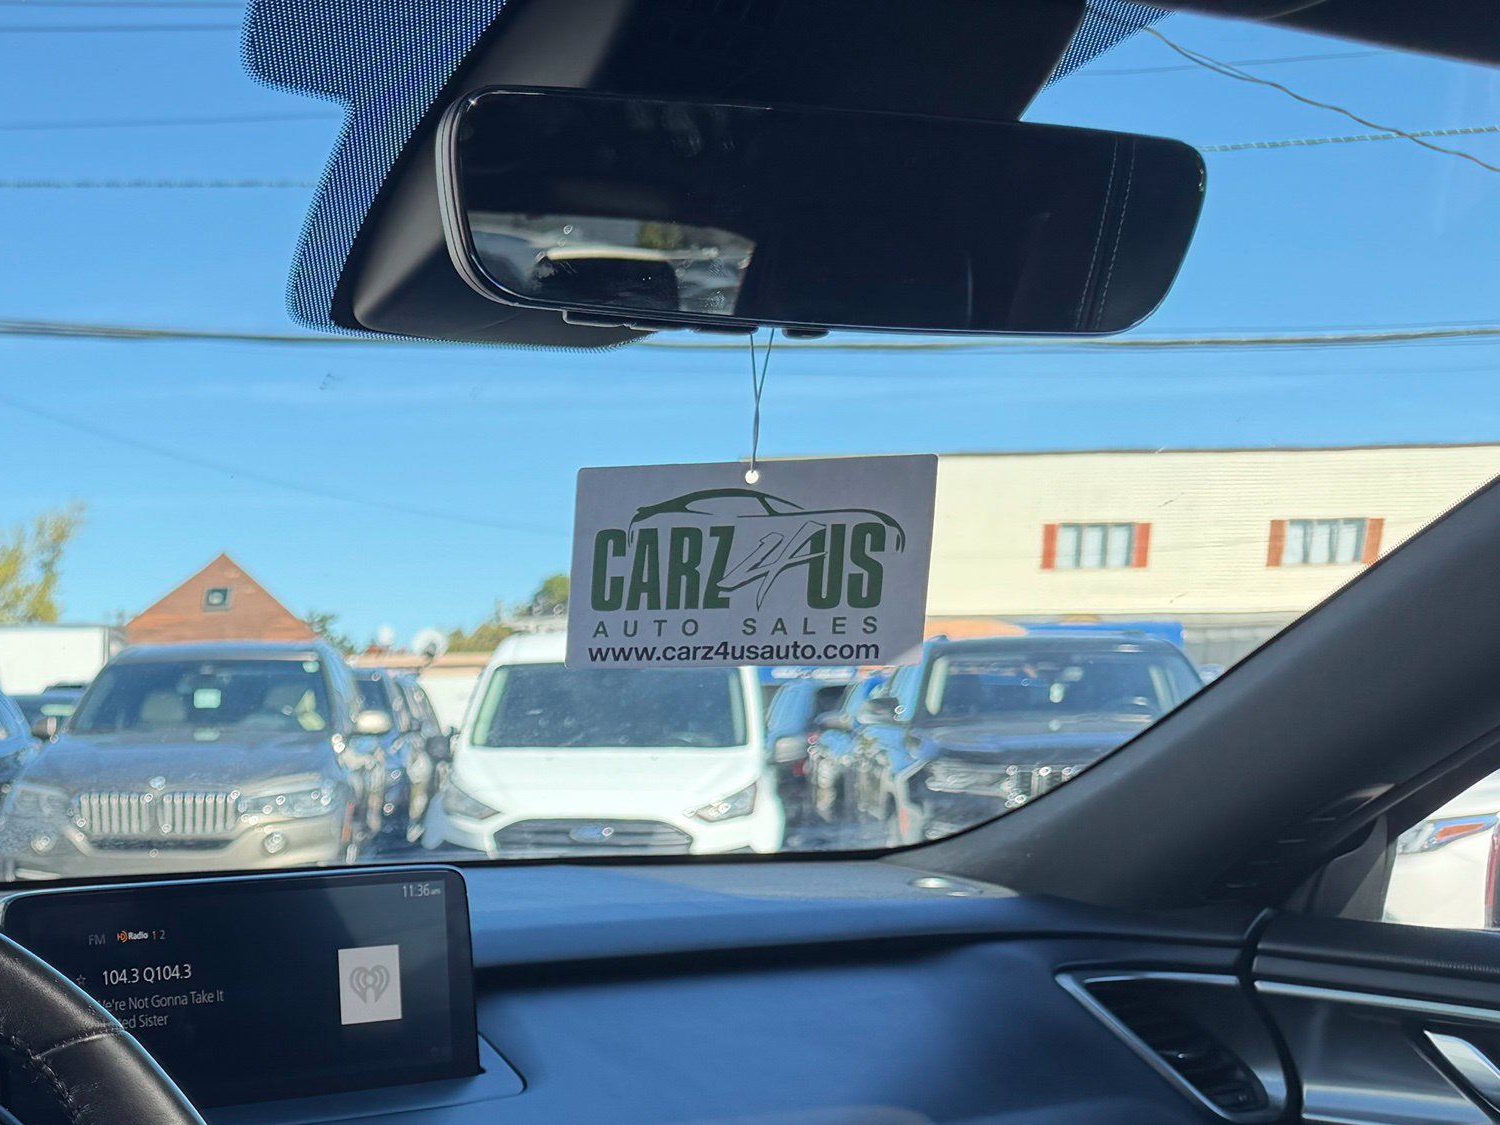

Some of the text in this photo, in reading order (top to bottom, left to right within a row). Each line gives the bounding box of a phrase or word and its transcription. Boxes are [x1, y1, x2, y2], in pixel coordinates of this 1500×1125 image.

[592, 615, 878, 639] AUTO SALES
[587, 640, 880, 663] www.carz4usauto.com
[88, 933, 106, 946] FM
[128, 930, 149, 941] Radio
[152, 930, 157, 940] 1
[159, 929, 166, 940] 2
[102, 963, 192, 986] 104.3 Q104.3
[128, 996, 150, 1010] Not
[151, 993, 189, 1009] Gonna
[189, 989, 216, 1005] Take
[216, 989, 225, 1003] It
[138, 1013, 169, 1029] Sister
